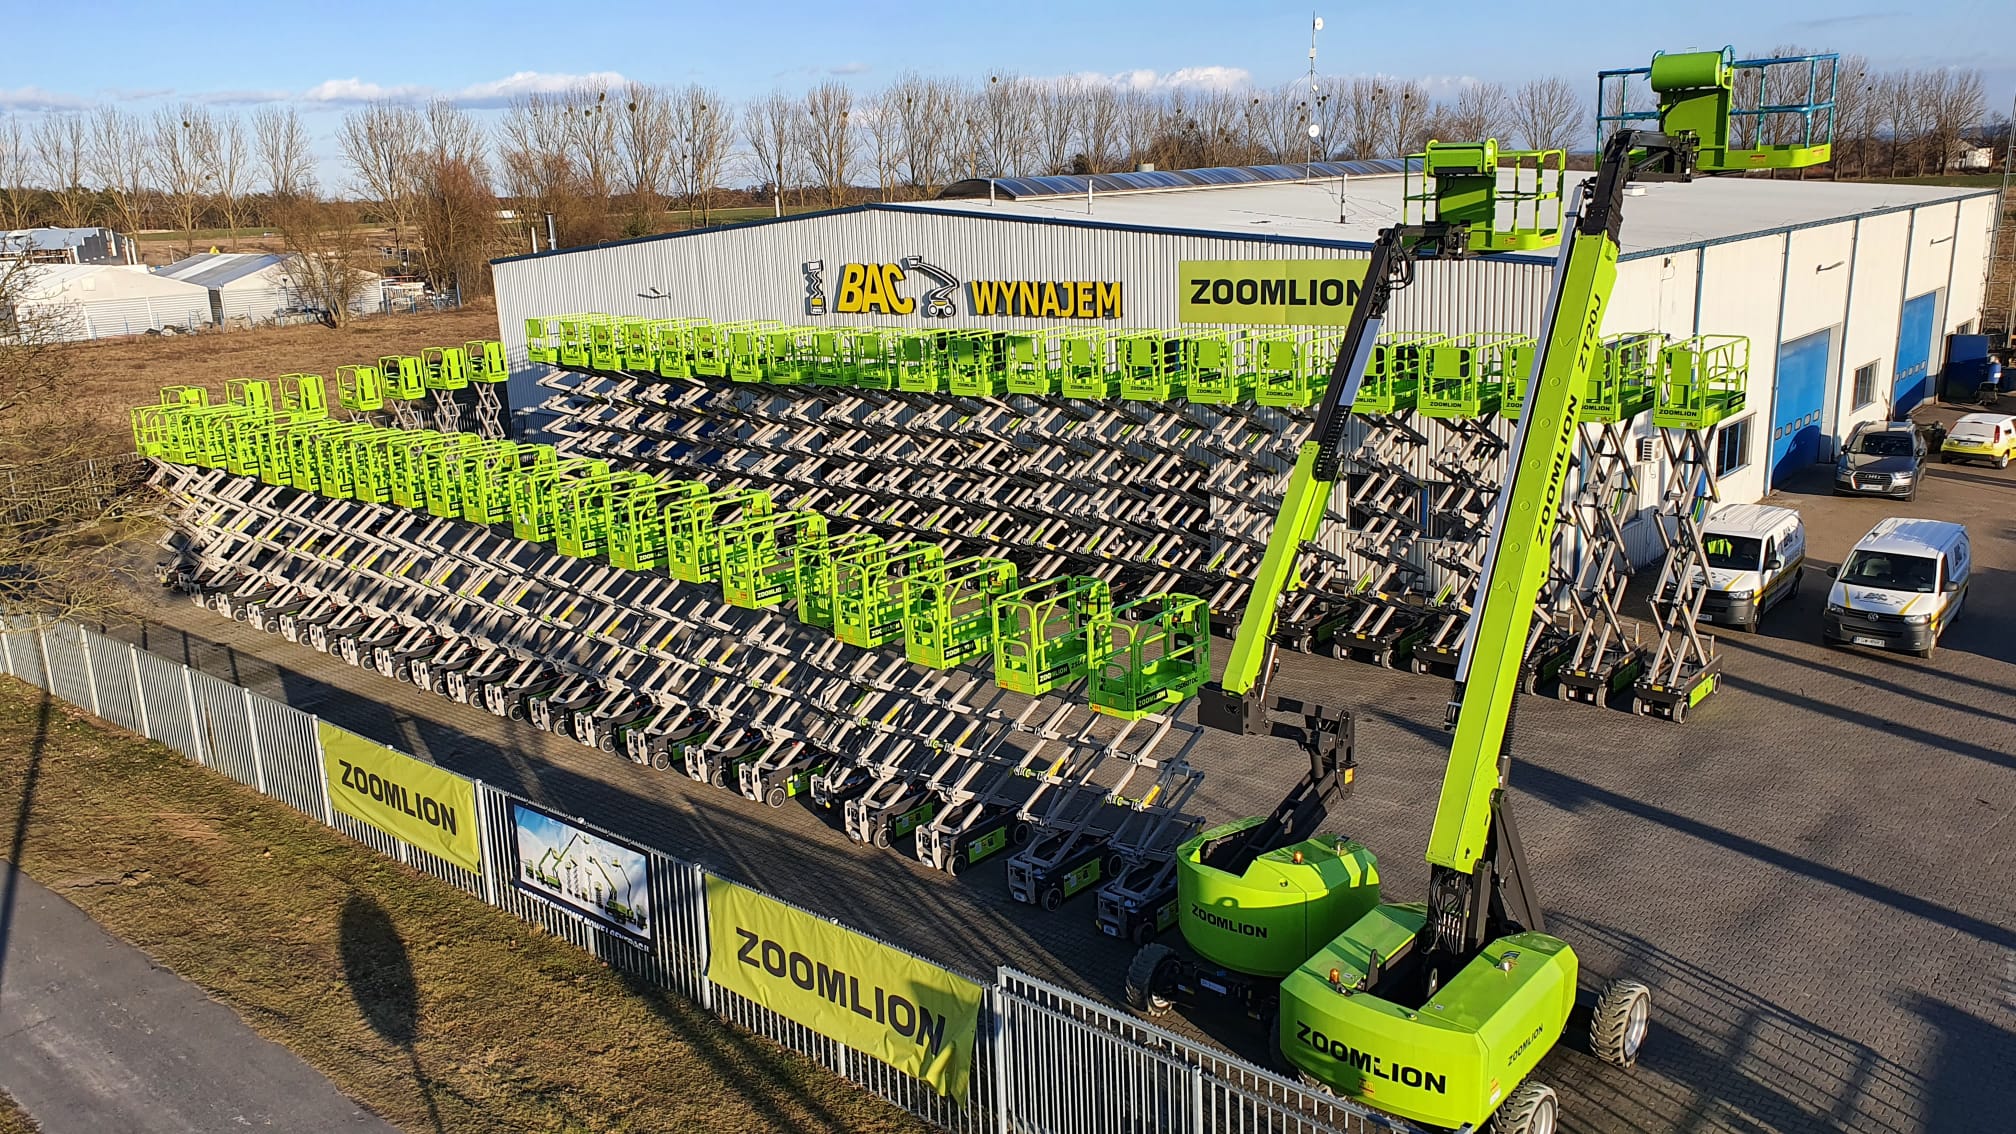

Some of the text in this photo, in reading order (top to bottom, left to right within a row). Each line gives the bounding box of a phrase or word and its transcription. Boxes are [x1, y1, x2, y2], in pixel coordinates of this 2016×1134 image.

[837, 262, 1123, 319] BAC WYNAJEM
[1191, 278, 1367, 307] ZOOMLION
[1430, 401, 1462, 409] ZOOMLION
[1535, 293, 1602, 546] ZOOMLION ZT20J
[1658, 409, 1698, 417] ZOOMLION
[1039, 665, 1068, 683] ZOOMLION
[338, 758, 457, 836] ZOOMLION
[1191, 903, 1269, 939] ZOOMLION
[736, 925, 947, 1057] ZOOMLION
[1296, 1019, 1447, 1094] ZOOMLION
[1507, 1023, 1544, 1067] ZOOMLION
